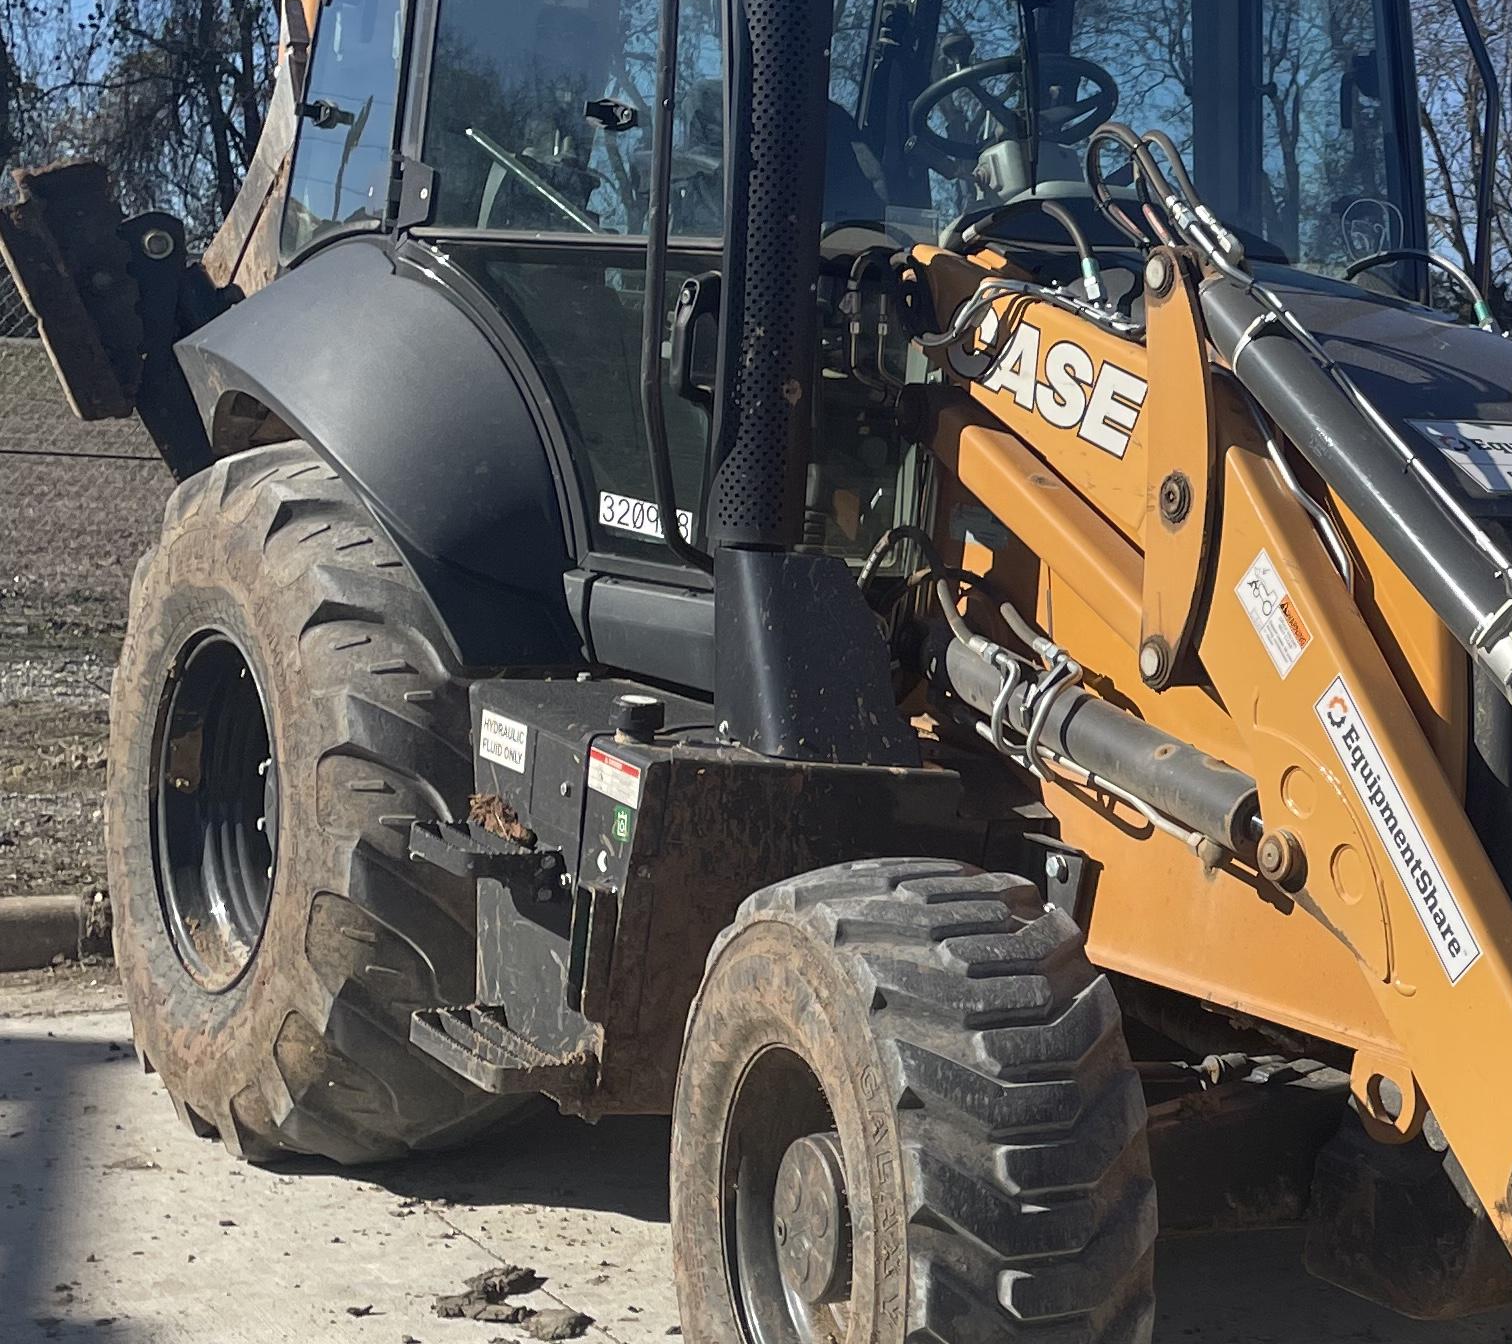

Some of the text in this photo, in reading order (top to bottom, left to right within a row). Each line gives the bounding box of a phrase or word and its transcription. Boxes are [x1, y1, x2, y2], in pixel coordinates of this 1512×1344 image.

[602, 494, 689, 541] 32098
[484, 717, 525, 745] HYDRAULIC
[482, 737, 523, 765] FLUID ONLY
[1342, 722, 1463, 959] EquipmentShare
